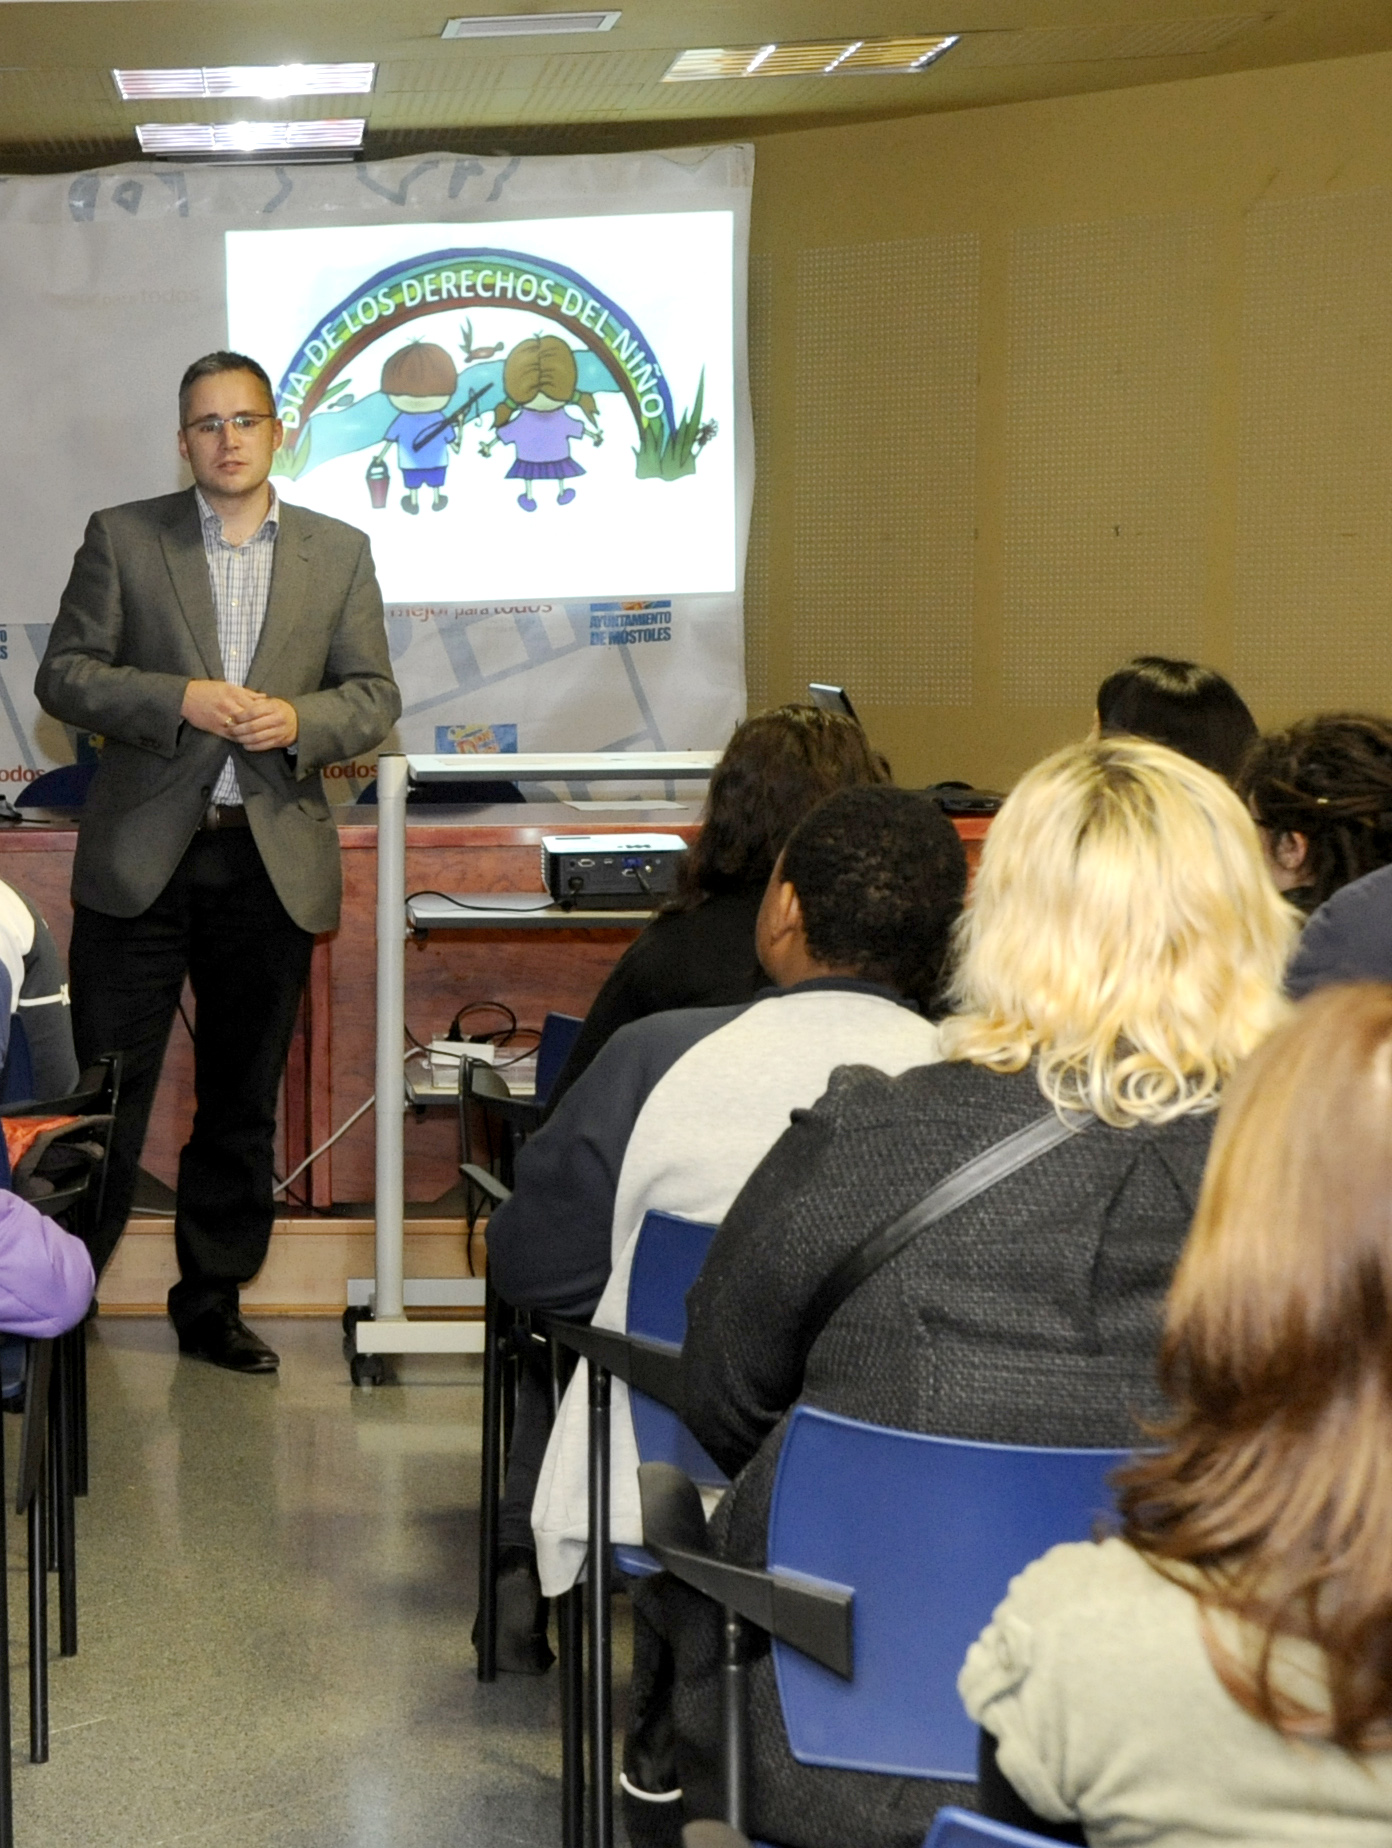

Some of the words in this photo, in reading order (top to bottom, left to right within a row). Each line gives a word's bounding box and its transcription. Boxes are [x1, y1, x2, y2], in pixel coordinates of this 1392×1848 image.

[303, 322, 343, 368] DE
[342, 287, 396, 334] LOS
[401, 269, 555, 308] DERECHOS
[560, 287, 609, 338] DEL
[611, 328, 665, 418] NIÑO
[589, 611, 672, 629] AYUNTAMIENTO
[589, 631, 607, 646] DE
[608, 627, 672, 646] MÓSTOLES
[323, 761, 379, 779] todos
